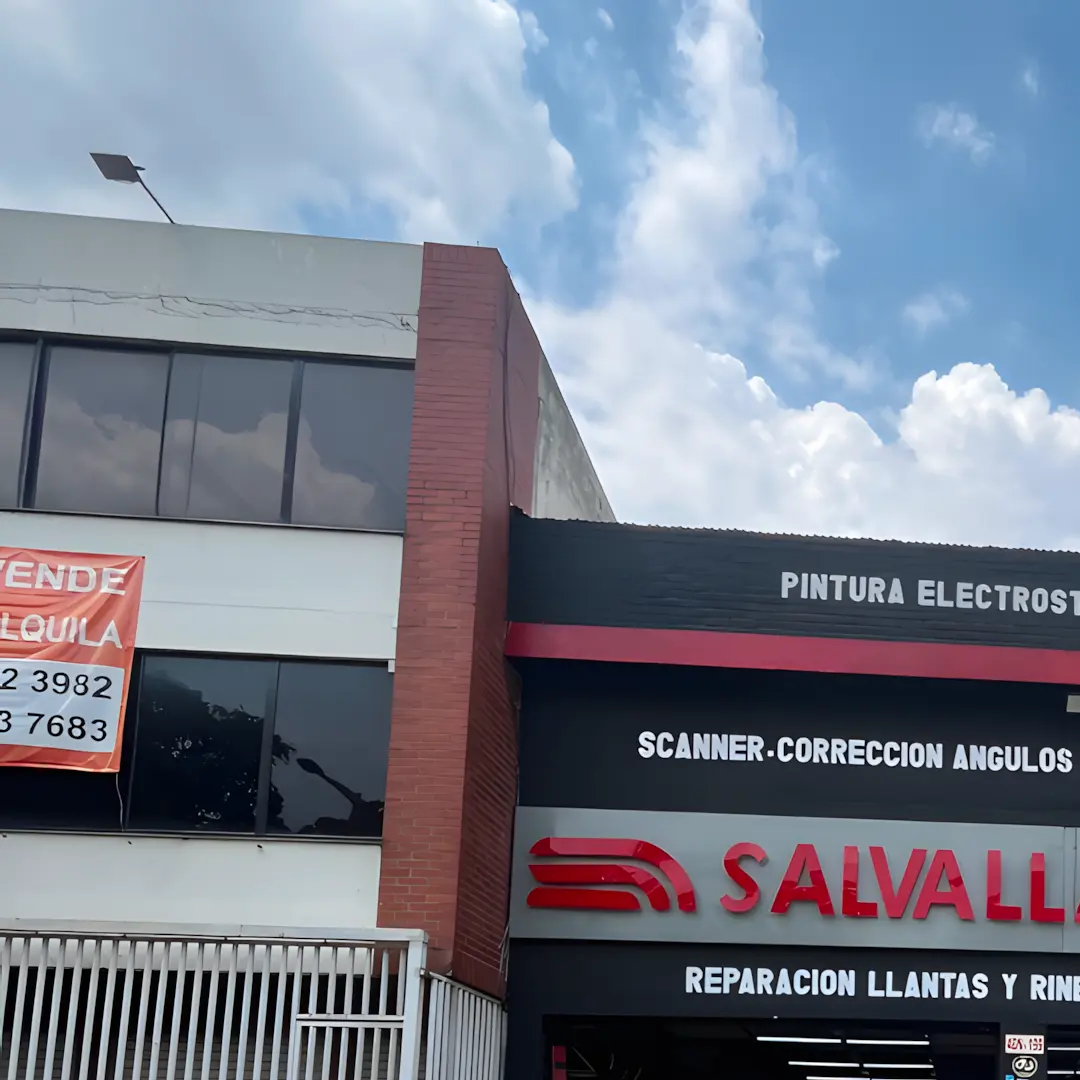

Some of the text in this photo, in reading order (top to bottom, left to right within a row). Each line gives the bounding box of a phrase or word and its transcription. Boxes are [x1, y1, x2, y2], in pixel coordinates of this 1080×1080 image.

[781, 571, 905, 605] PINTURA
[0, 611, 123, 649] LQUILA
[31, 670, 112, 700] 3982
[27, 712, 108, 742] 7683
[952, 743, 1073, 773] ANGULOS
[685, 966, 856, 997] REPARACION
[867, 970, 989, 999] LLANTAS
[1001, 973, 1018, 1000] Y
